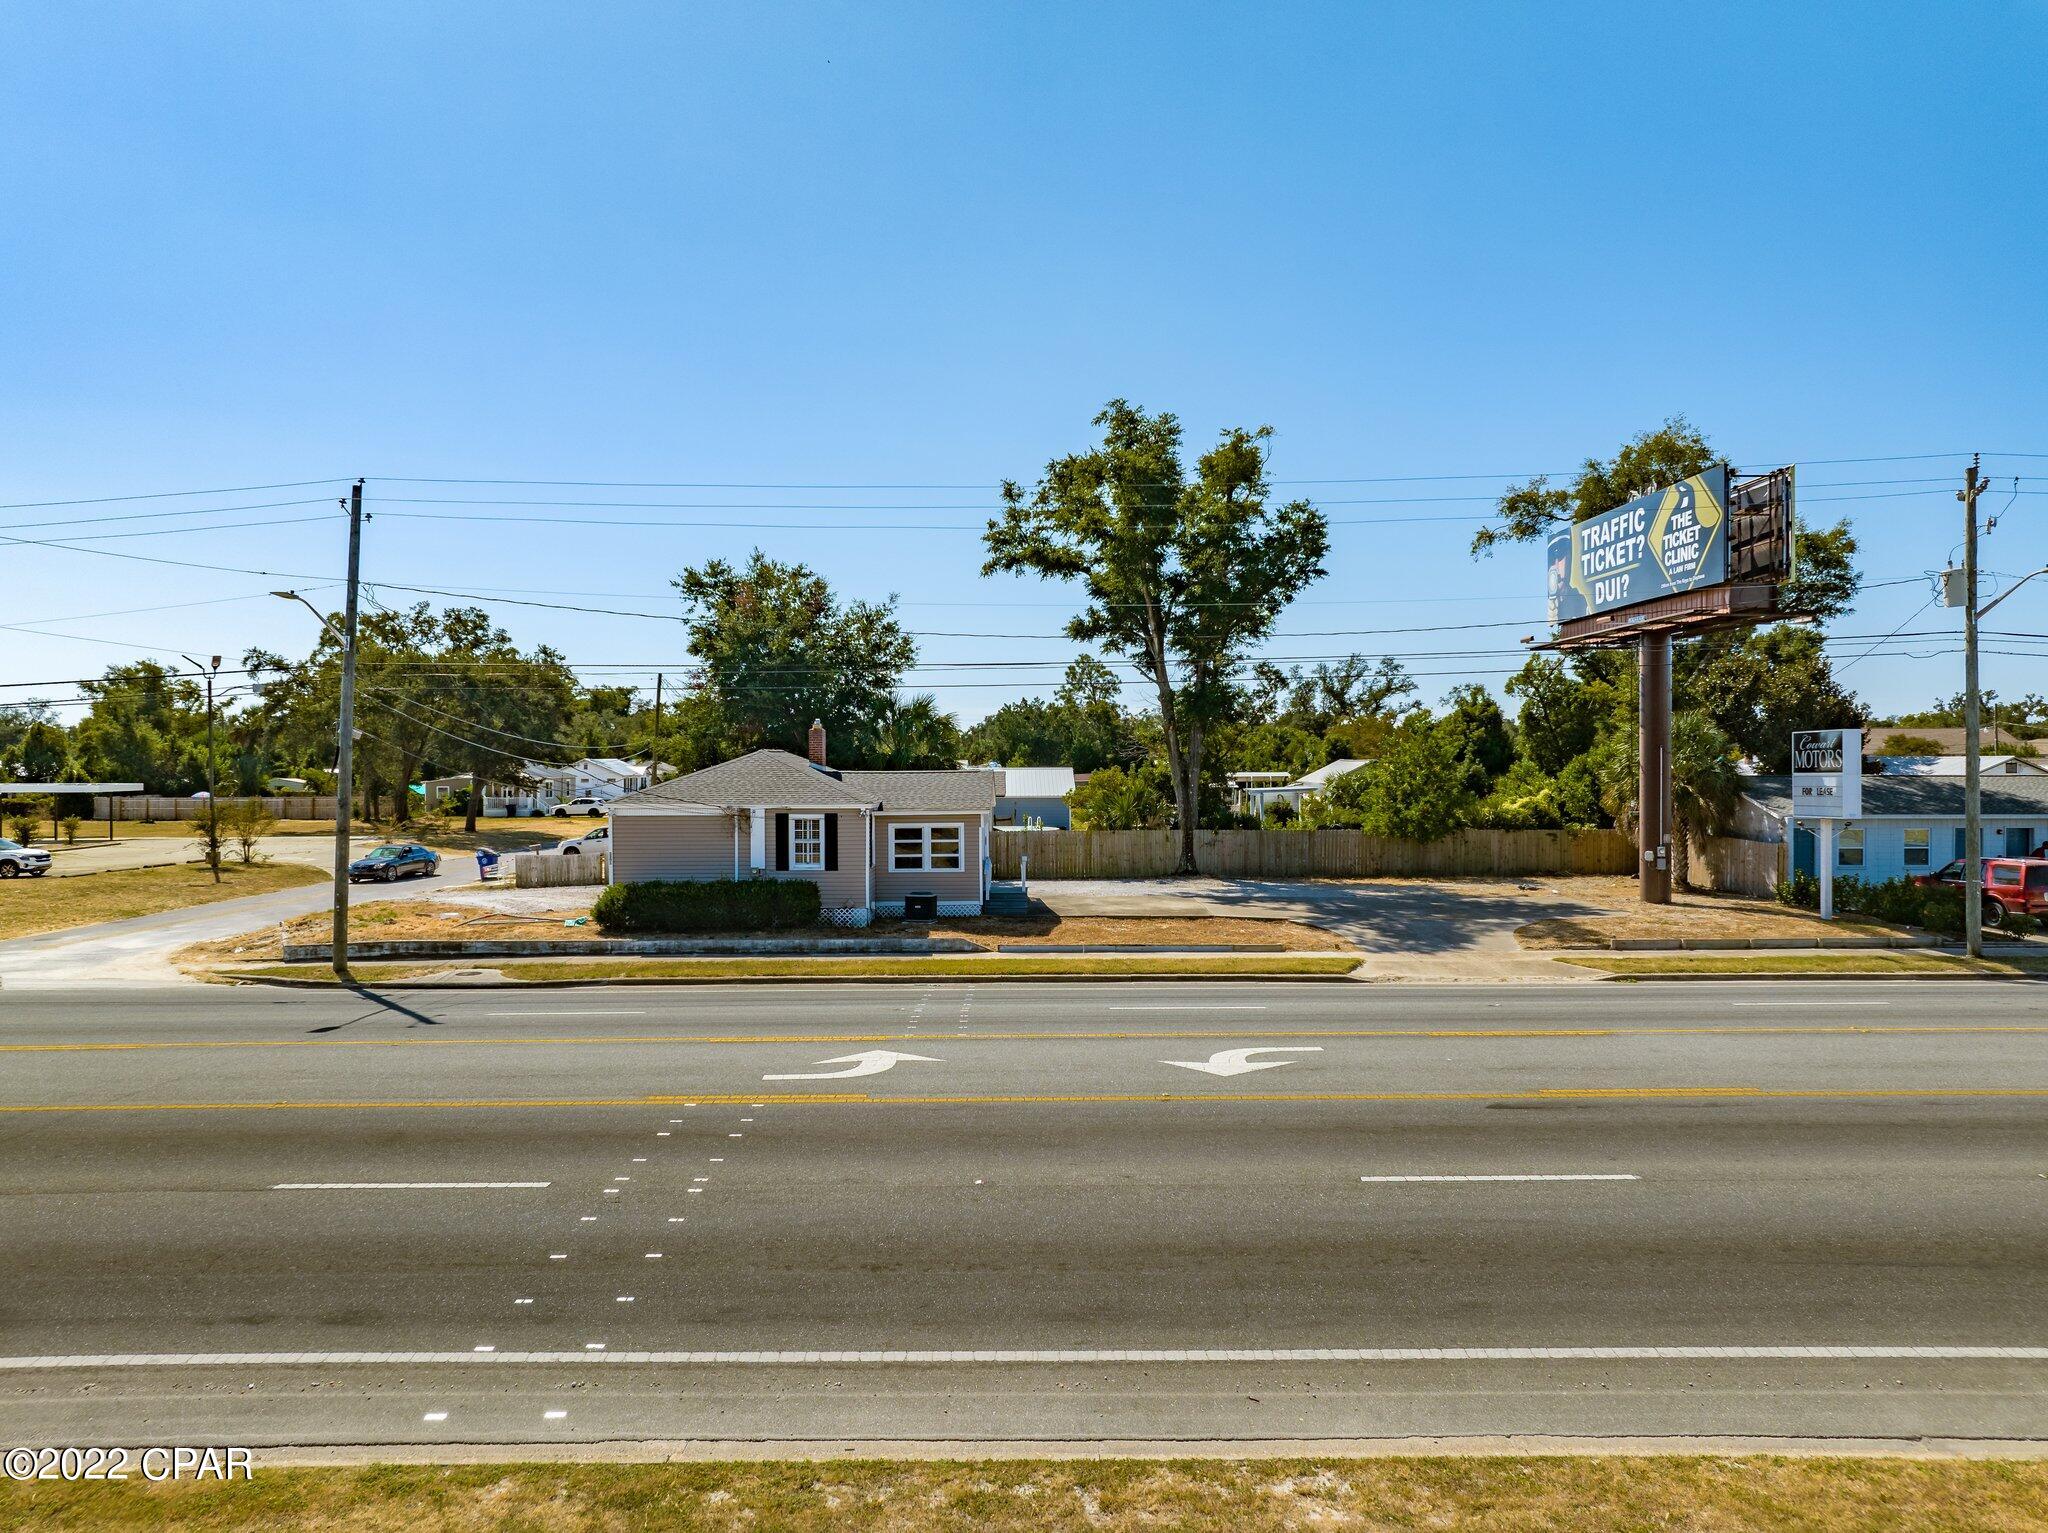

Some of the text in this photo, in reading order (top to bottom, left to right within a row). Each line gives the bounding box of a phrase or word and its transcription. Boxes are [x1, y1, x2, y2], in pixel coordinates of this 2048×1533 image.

[1581, 507, 1645, 551] TRAFFIC
[1671, 510, 1692, 531] THE
[1663, 525, 1701, 550] TICKET
[1581, 534, 1645, 576] TICKET?
[1664, 543, 1699, 567] CLINIC
[1673, 564, 1684, 575] LAW
[1595, 573, 1630, 605] DUI?
[1800, 734, 1837, 751] Cowart
[1795, 749, 1843, 769] MOTORS
[1802, 787, 1833, 796] FOR LEASE
